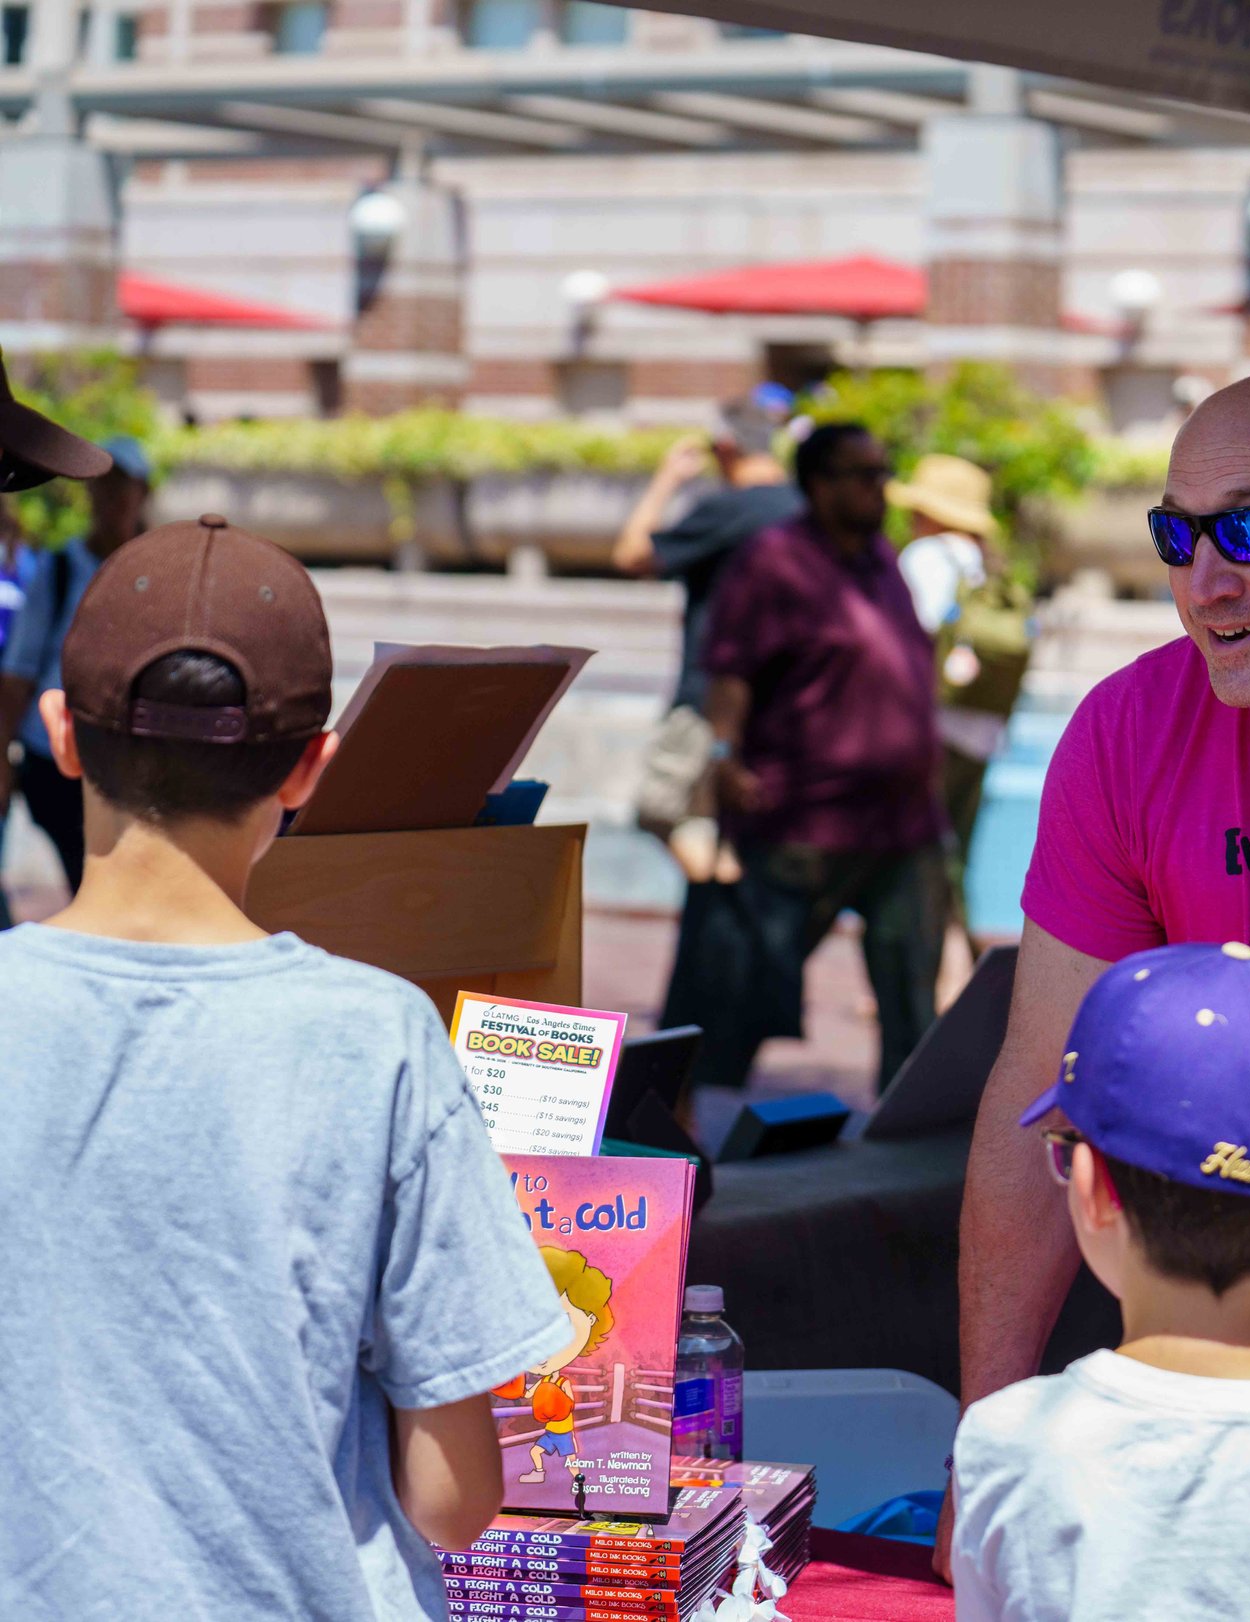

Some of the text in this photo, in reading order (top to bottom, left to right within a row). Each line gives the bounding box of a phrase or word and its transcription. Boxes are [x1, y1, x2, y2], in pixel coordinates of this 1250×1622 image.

[480, 1019, 594, 1044] FESTIVAL OF BOOKS
[526, 1015, 540, 1025] Los
[543, 1018, 571, 1029] Angeles
[572, 1022, 597, 1032] Times
[467, 1031, 602, 1067] BOOK SALE!
[471, 1066, 484, 1076] for
[486, 1067, 506, 1080] $20
[483, 1084, 503, 1097] $30
[539, 1094, 557, 1105] ($10
[559, 1097, 590, 1109] savings)
[480, 1100, 587, 1125] $45 ($15 savings)
[483, 1118, 583, 1142] 60 ($20 savings)
[528, 1144, 547, 1154] ($25
[524, 1173, 548, 1193] to
[559, 1216, 573, 1235] a
[575, 1194, 648, 1232] cold
[564, 1459, 652, 1470] Adam T. Newman
[610, 1451, 652, 1461] written by
[599, 1475, 650, 1486] illustrated by
[604, 1484, 615, 1494] G.
[618, 1485, 650, 1498] Young
[516, 1532, 525, 1541] A
[530, 1534, 562, 1544] COLD
[627, 1541, 652, 1549] BOOKS
[471, 1542, 506, 1553] FIGHT
[511, 1544, 520, 1553] A
[526, 1546, 557, 1556] COLD
[622, 1554, 647, 1562] BOOKS
[450, 1554, 466, 1564] TO
[471, 1556, 507, 1567] FIGHT
[512, 1559, 521, 1568] A
[527, 1561, 558, 1571] COLD
[623, 1569, 648, 1577] BOOKS
[452, 1565, 467, 1574] TO
[473, 1566, 508, 1578] FIGHT
[513, 1569, 522, 1578] A
[529, 1571, 560, 1581] COLD
[624, 1579, 649, 1587] BOOKS
[444, 1579, 460, 1588] TO
[465, 1580, 501, 1591] FIGHT
[506, 1582, 515, 1591] A
[521, 1584, 552, 1594] COLD
[617, 1591, 642, 1599] BOOKS
[448, 1589, 463, 1599] TO
[468, 1591, 504, 1601] FIGHT
[510, 1593, 519, 1602] A
[525, 1595, 556, 1605] COLD
[448, 1602, 465, 1611] TO
[469, 1603, 505, 1614] FIGHT
[511, 1605, 520, 1614] A
[526, 1607, 558, 1617] COLD
